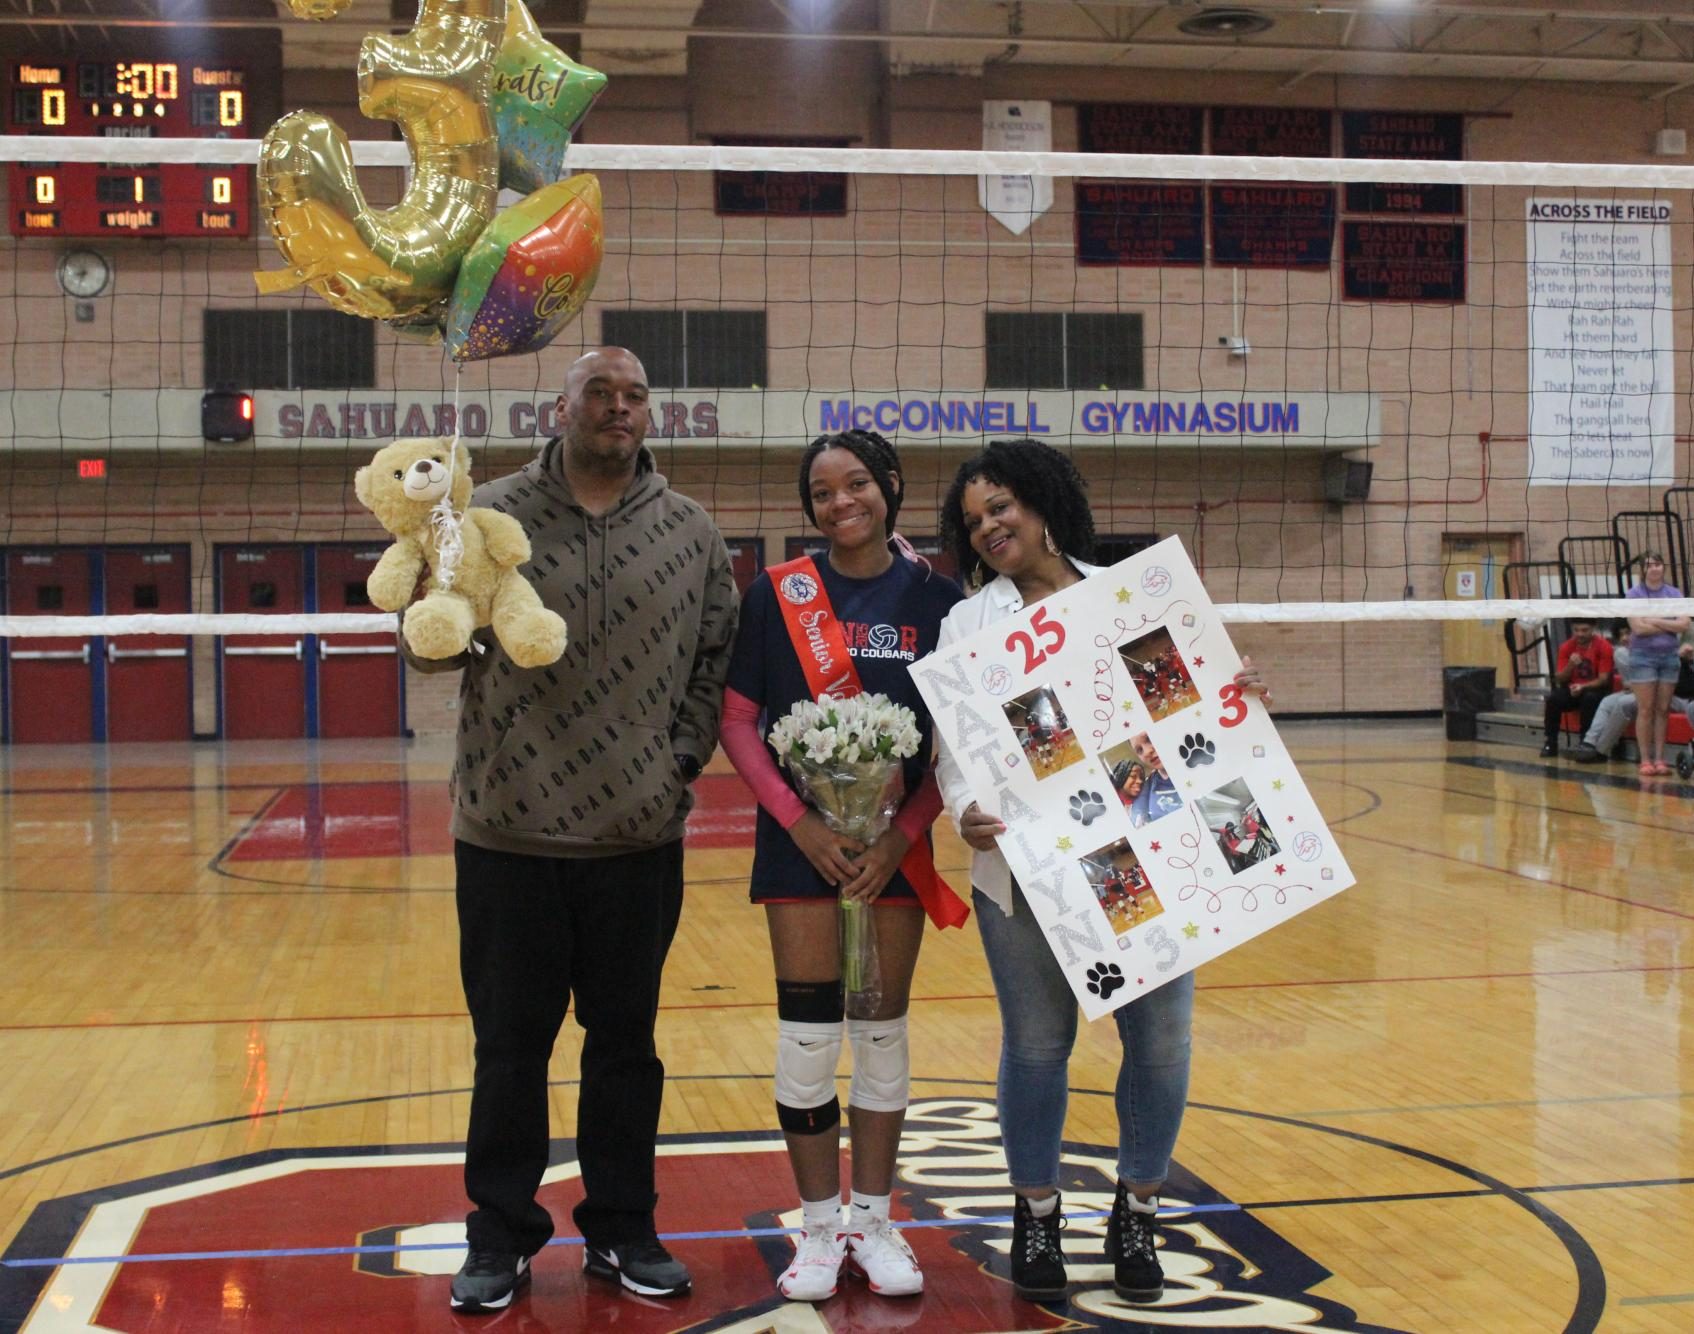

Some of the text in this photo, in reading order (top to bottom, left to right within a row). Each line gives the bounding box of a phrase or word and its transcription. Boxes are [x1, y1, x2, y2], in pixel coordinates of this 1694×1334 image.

[20, 65, 60, 83] Home
[42, 89, 65, 125] 0
[220, 91, 242, 126] 0
[36, 176, 54, 203] 0
[213, 177, 230, 203] 0
[1086, 188, 1196, 204] SAHUARO
[1220, 190, 1327, 207] SAHUARO
[106, 210, 153, 229] weight
[1530, 204, 1670, 219] ACROSS THE FIELD
[1357, 225, 1453, 243] SAHUARO
[1560, 232, 1639, 246] Fight the team
[1560, 249, 1641, 261] Across the field
[1529, 265, 1559, 277] Show
[1561, 265, 1590, 277] them
[1646, 267, 1670, 278] here
[1548, 281, 1567, 293] the
[1568, 315, 1634, 326] Rah Rah Rah
[1582, 332, 1610, 343] them
[1613, 332, 1638, 343] hard
[1544, 349, 1566, 360] And
[1577, 365, 1608, 377] Never
[1543, 381, 1567, 392] That
[1623, 382, 1638, 393] the
[1580, 398, 1624, 409] Hail Hail
[279, 402, 720, 439] SAHUARO COARS
[1081, 401, 1300, 434] GYMNASIUM
[1554, 414, 1572, 425] The
[1626, 415, 1651, 426] here
[1551, 447, 1571, 458] The
[79, 459, 106, 478] EXIT
[799, 610, 834, 675] Senior
[1005, 605, 1066, 675] 25
[861, 648, 916, 662] COUGARS
[1218, 682, 1249, 729] 3
[538, 724, 620, 799] JORDAN
[1143, 923, 1182, 973] 3
